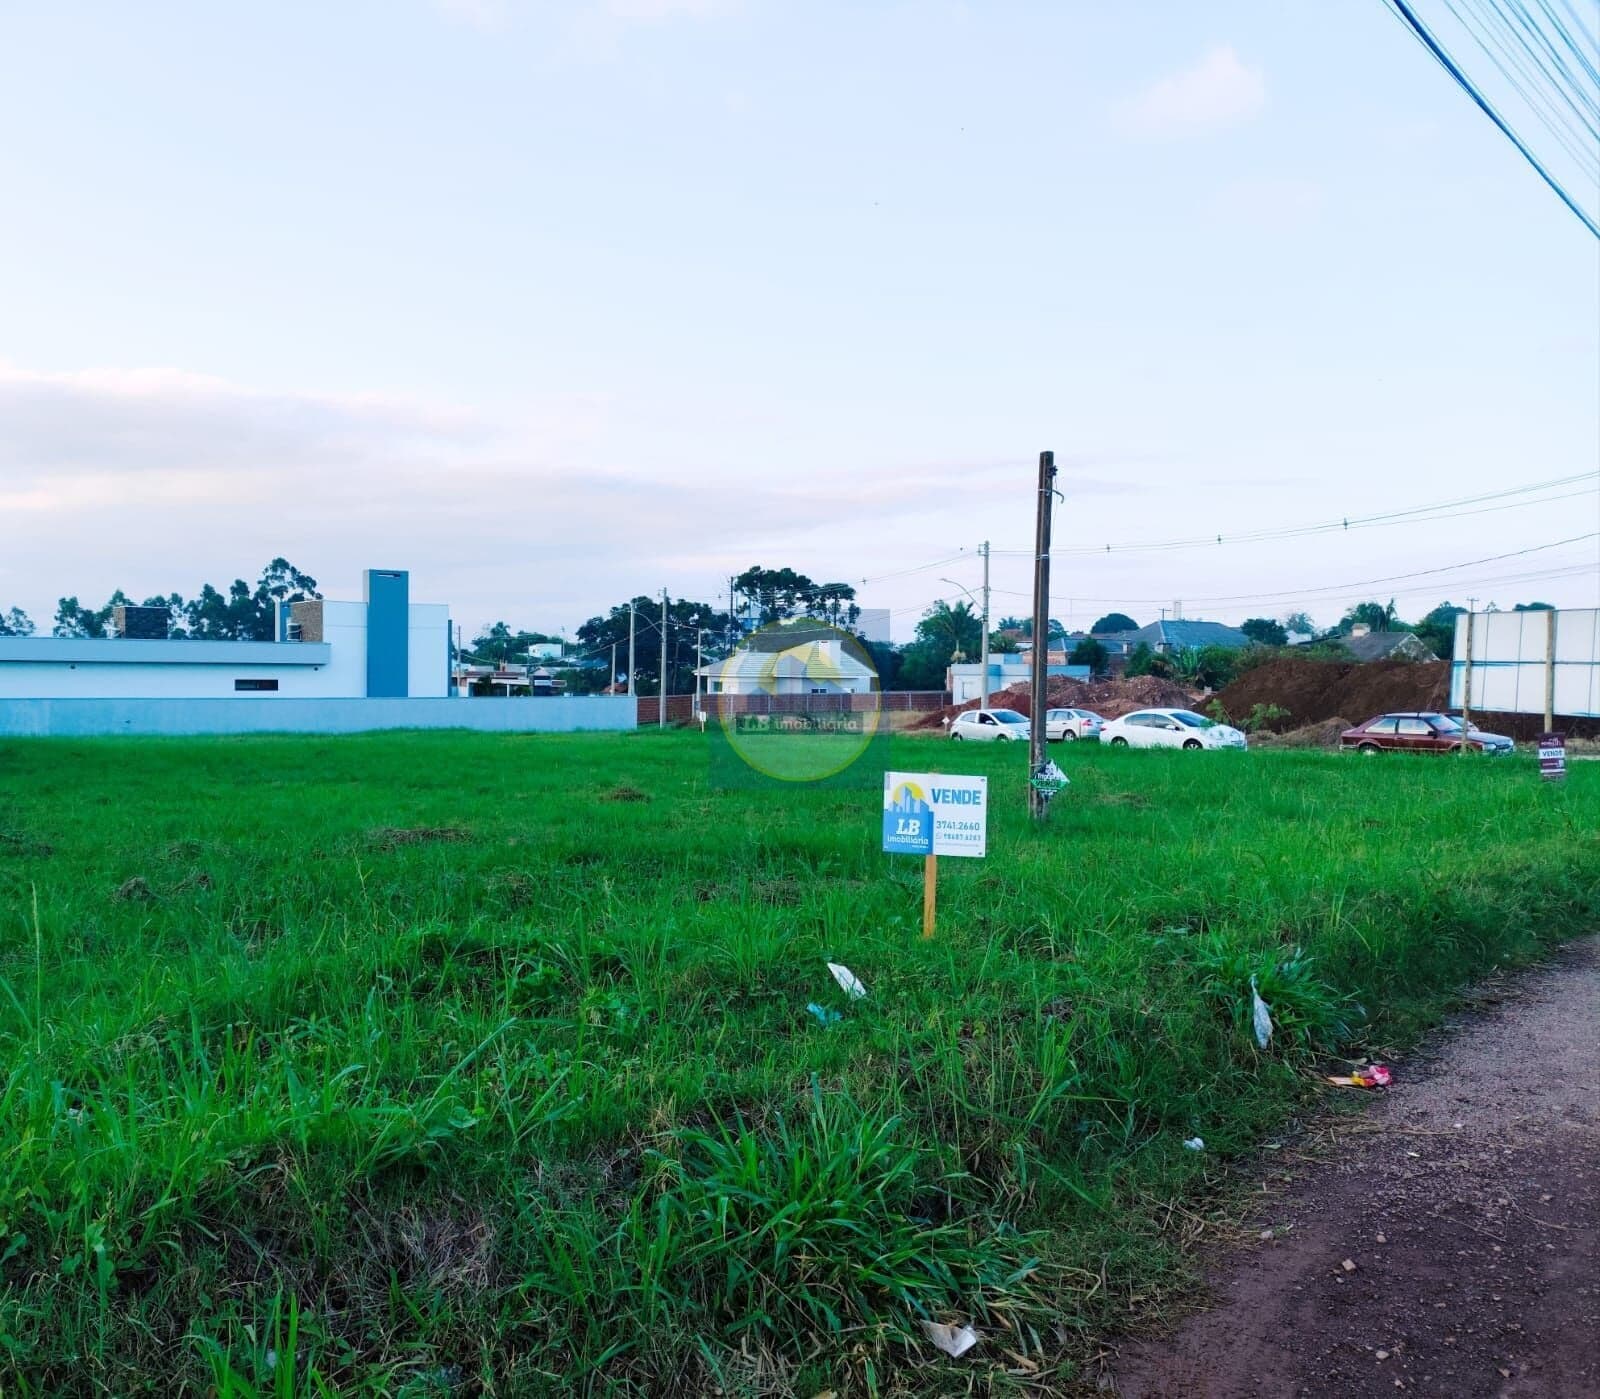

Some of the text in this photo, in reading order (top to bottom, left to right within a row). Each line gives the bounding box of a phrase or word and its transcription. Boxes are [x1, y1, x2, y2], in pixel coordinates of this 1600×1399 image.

[931, 788, 982, 805] VENDE
[896, 818, 921, 836] LB
[936, 820, 980, 831] 3741.2660
